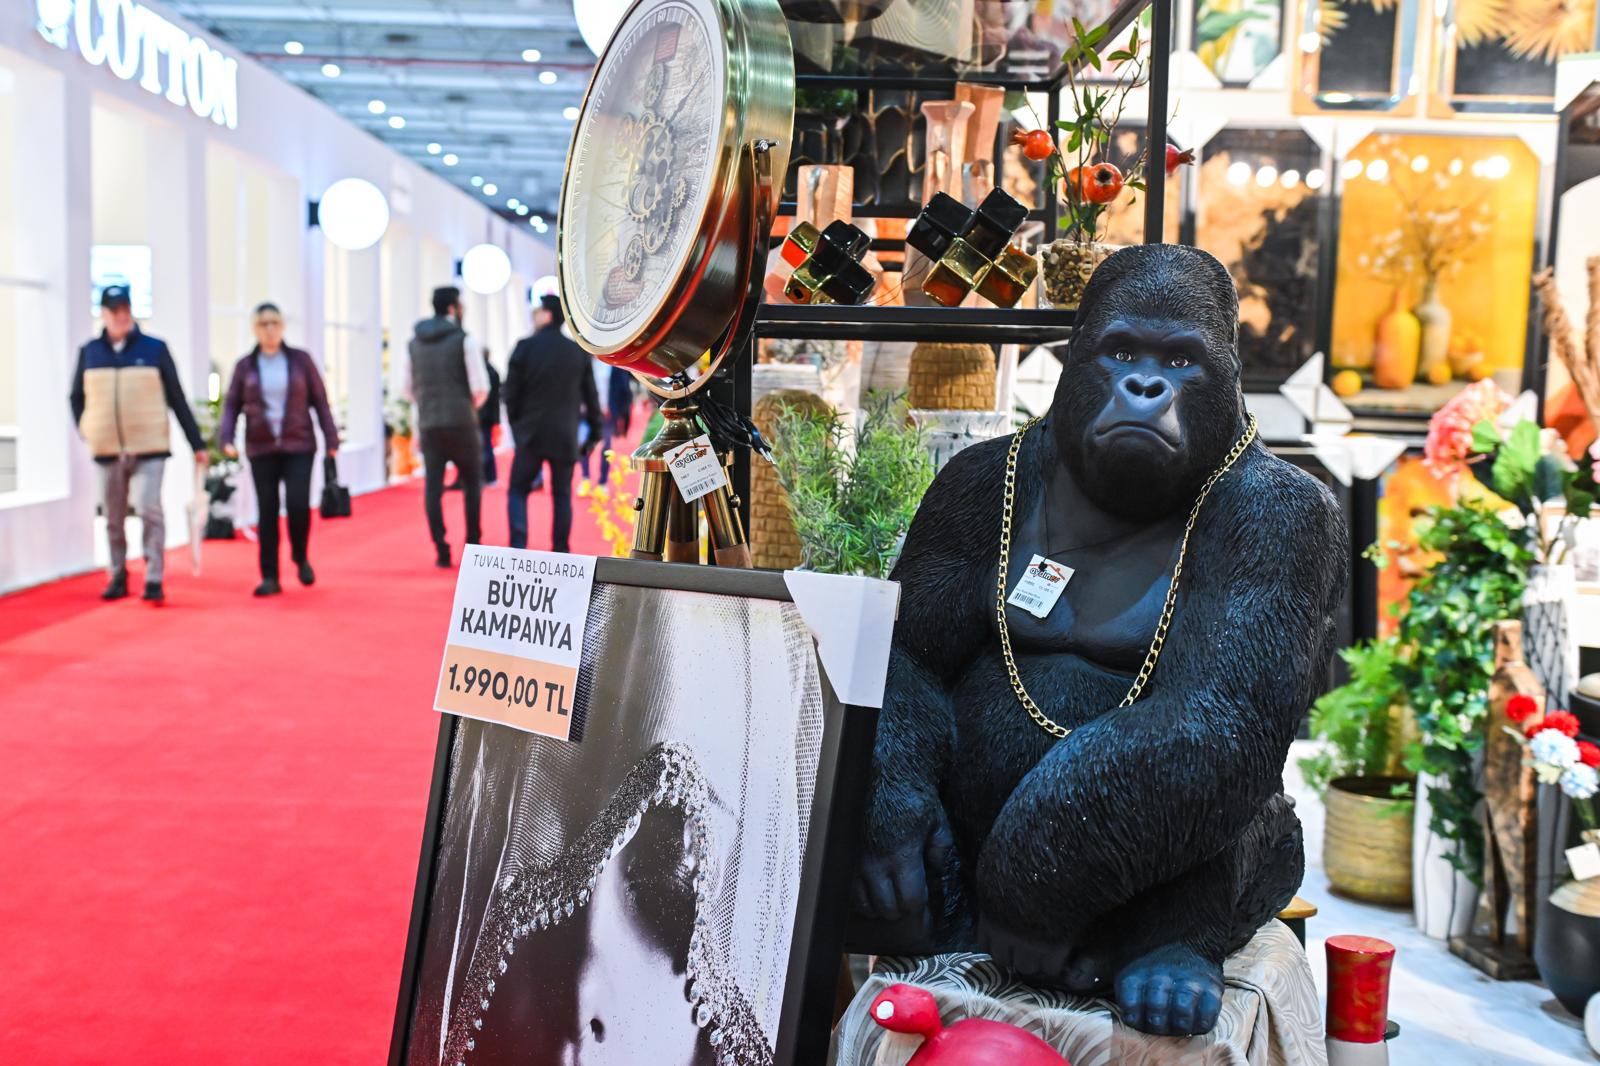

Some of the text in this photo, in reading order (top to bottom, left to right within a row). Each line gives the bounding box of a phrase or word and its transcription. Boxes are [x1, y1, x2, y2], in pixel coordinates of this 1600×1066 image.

[74, 0, 238, 130] COTTON
[474, 554, 585, 580] TUVAL TABLOLARDA
[487, 574, 557, 614] BÜYÜK
[460, 607, 572, 650] KAMPANYA
[448, 663, 569, 716] 1.990,00 TL
